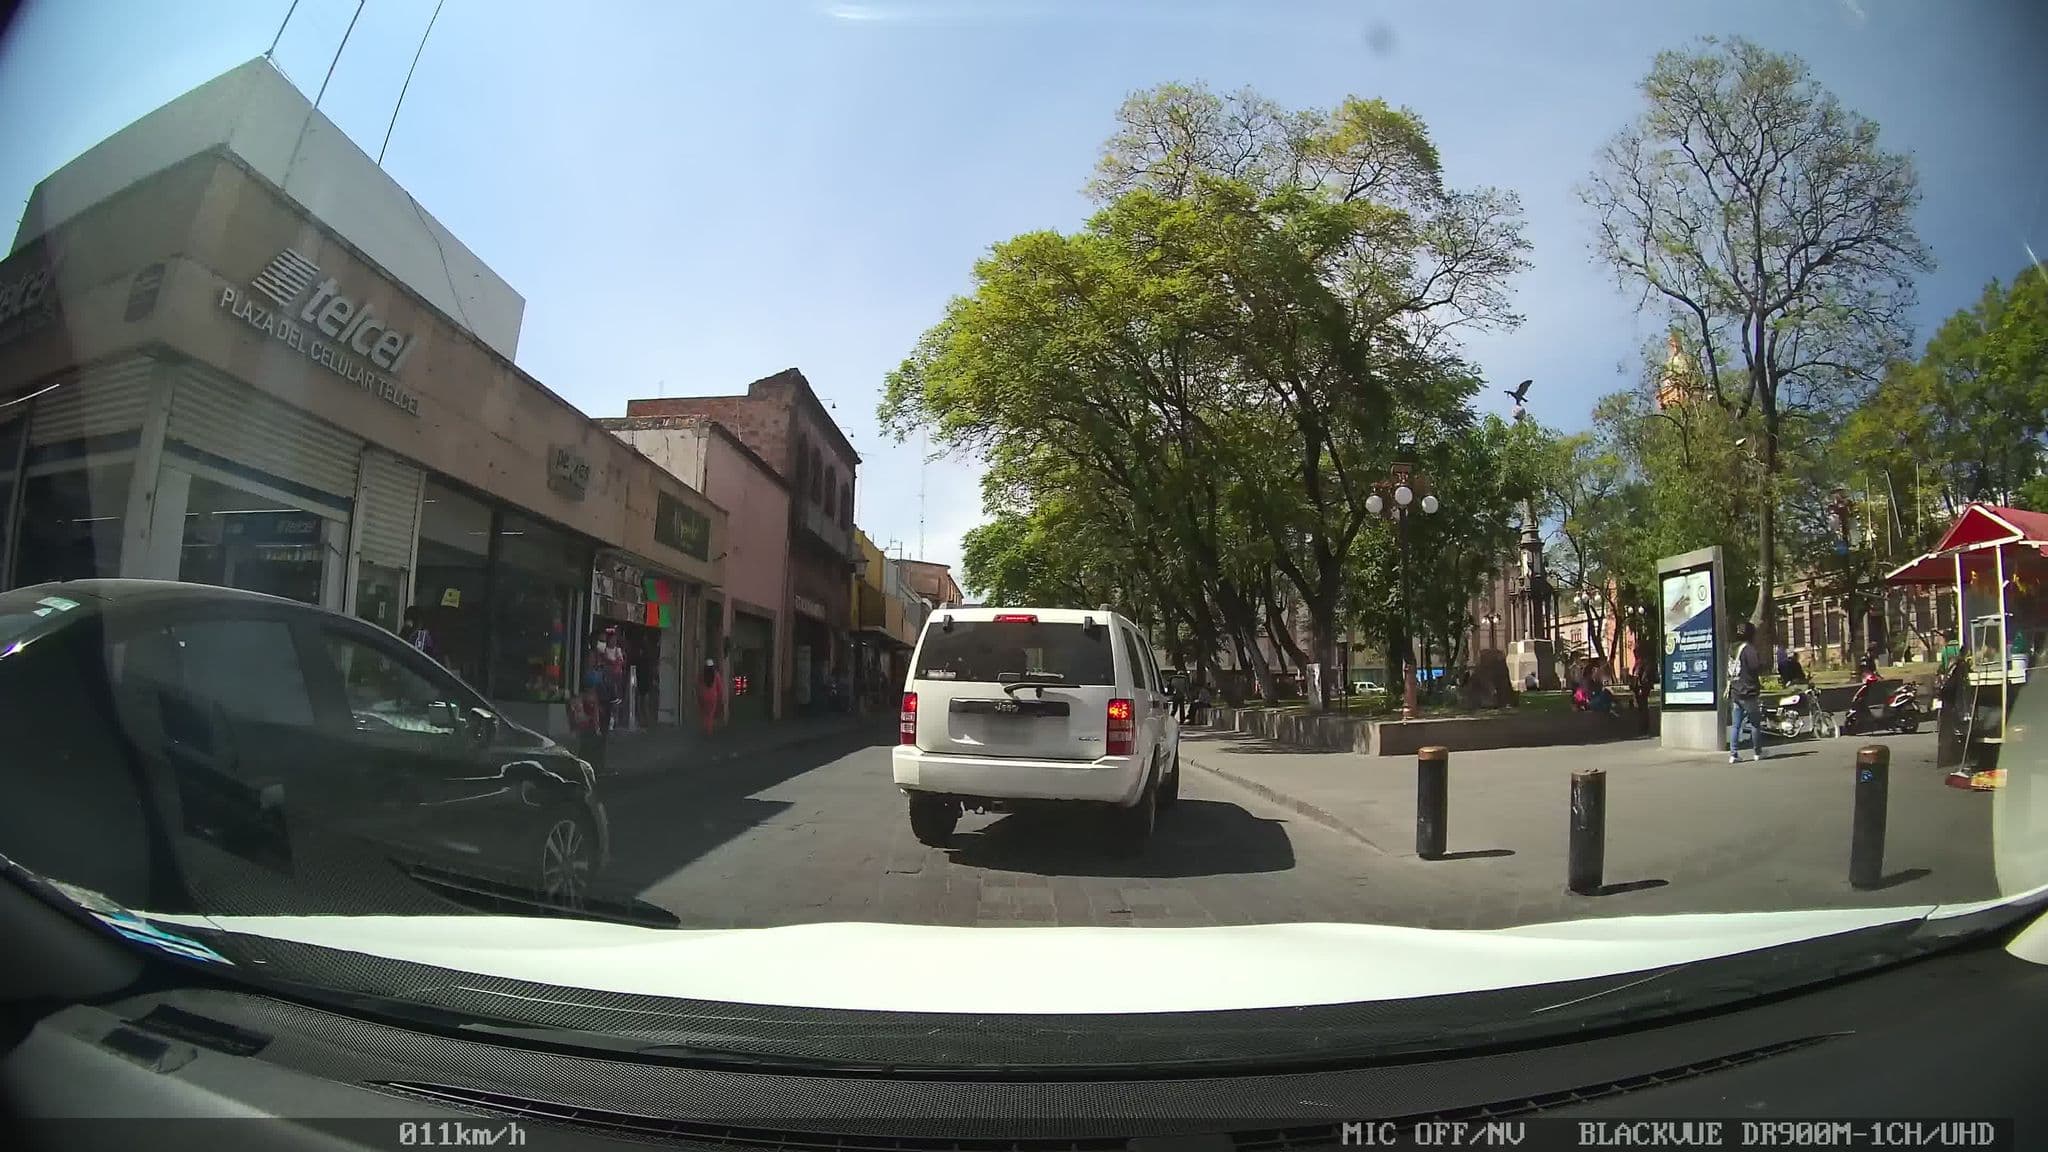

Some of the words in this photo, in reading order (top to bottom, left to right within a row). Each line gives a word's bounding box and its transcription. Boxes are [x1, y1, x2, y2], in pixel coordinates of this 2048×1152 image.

[221, 287, 274, 336] PLAZA
[276, 319, 305, 354] DEL
[310, 341, 375, 391] CELULAR
[379, 378, 424, 417] TELCEL
[301, 278, 418, 373] telcel
